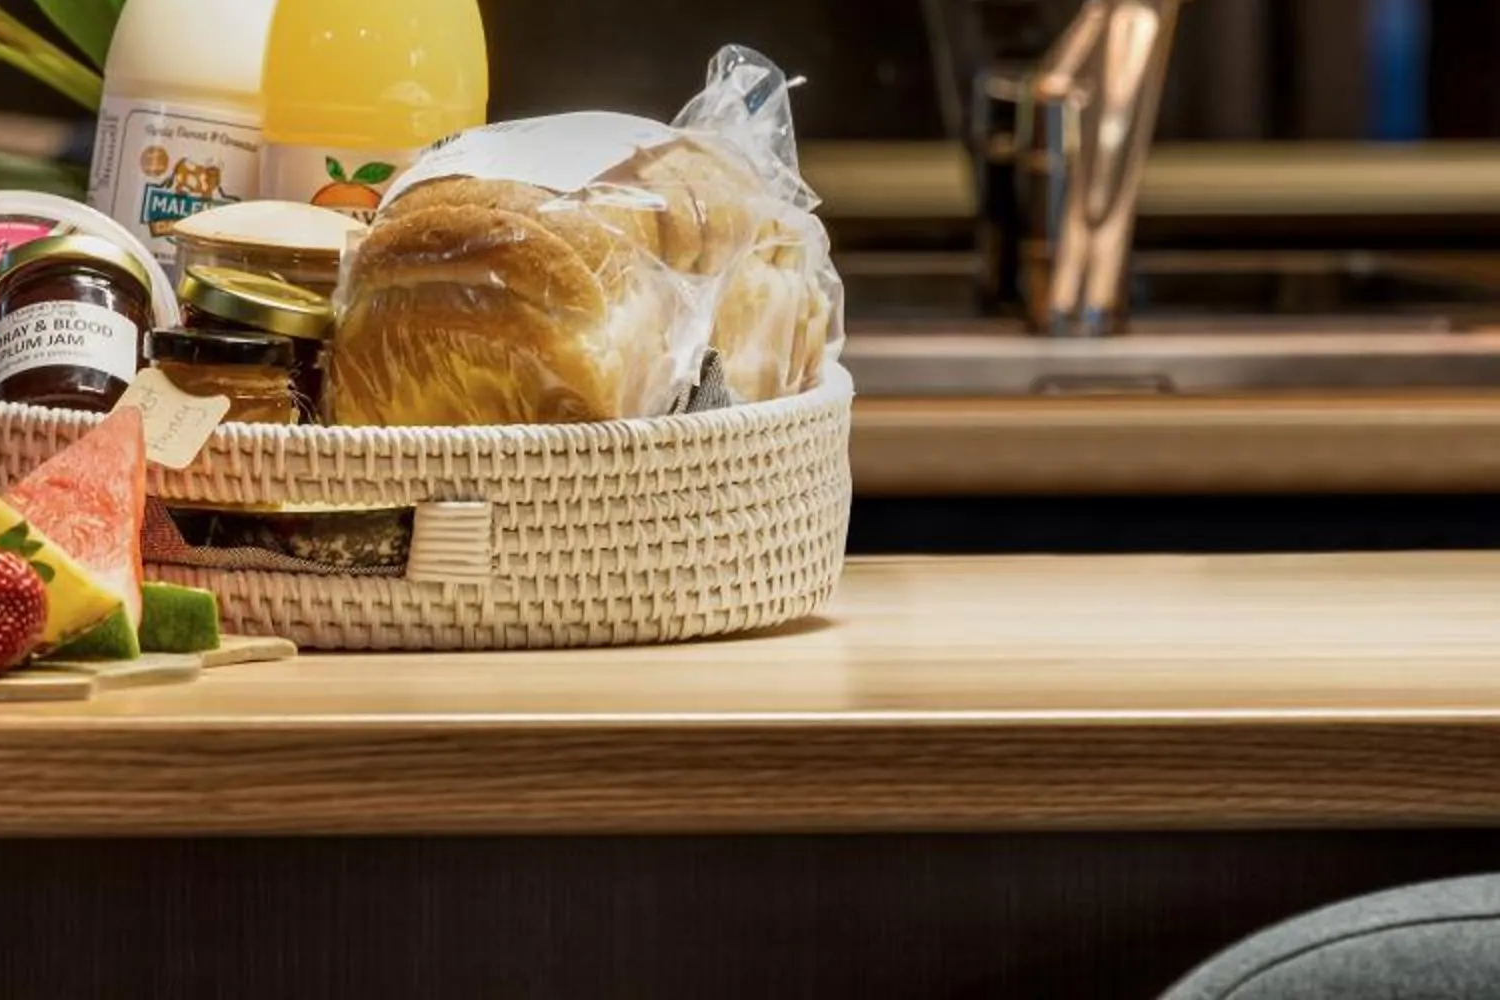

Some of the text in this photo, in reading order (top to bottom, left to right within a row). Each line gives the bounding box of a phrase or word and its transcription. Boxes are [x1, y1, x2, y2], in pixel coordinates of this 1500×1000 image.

[152, 195, 213, 217] MALE
[34, 319, 47, 333] &
[53, 318, 114, 338] BLOOD
[46, 333, 85, 346] JAM
